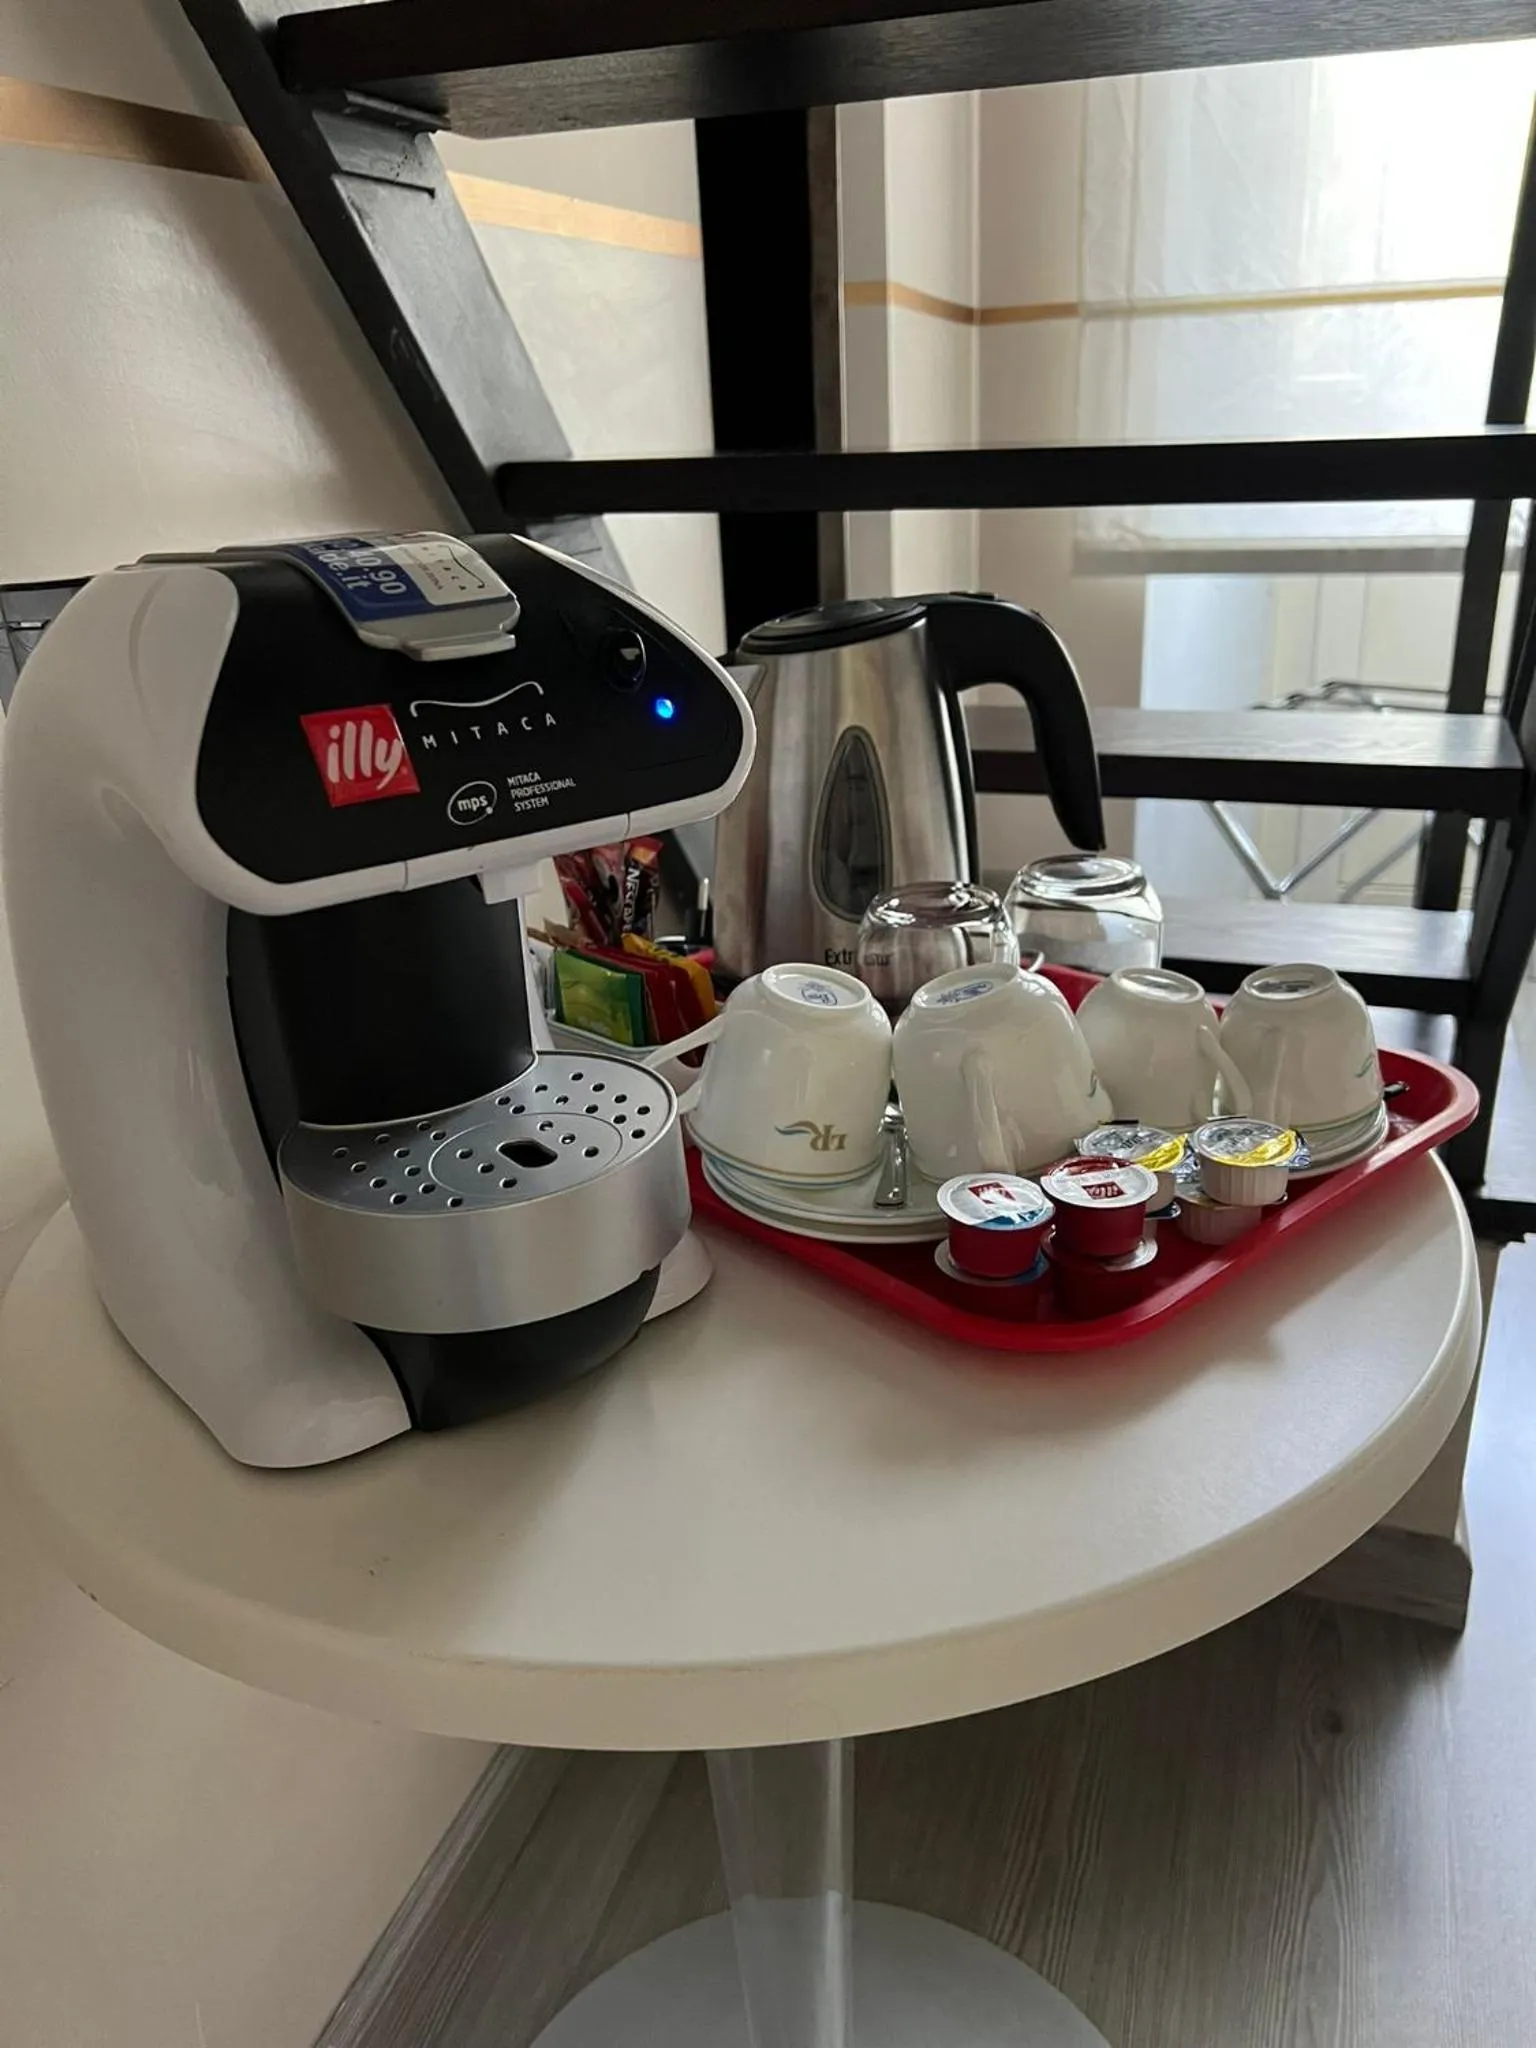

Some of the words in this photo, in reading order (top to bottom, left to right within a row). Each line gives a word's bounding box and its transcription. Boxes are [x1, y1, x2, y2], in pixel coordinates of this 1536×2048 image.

[422, 712, 557, 749] MITACA
[327, 720, 403, 790] illy
[506, 771, 541, 787] MITACA
[510, 778, 577, 799] PROFESSIONAL
[457, 795, 488, 811] mps
[514, 796, 550, 812] SYSTEM
